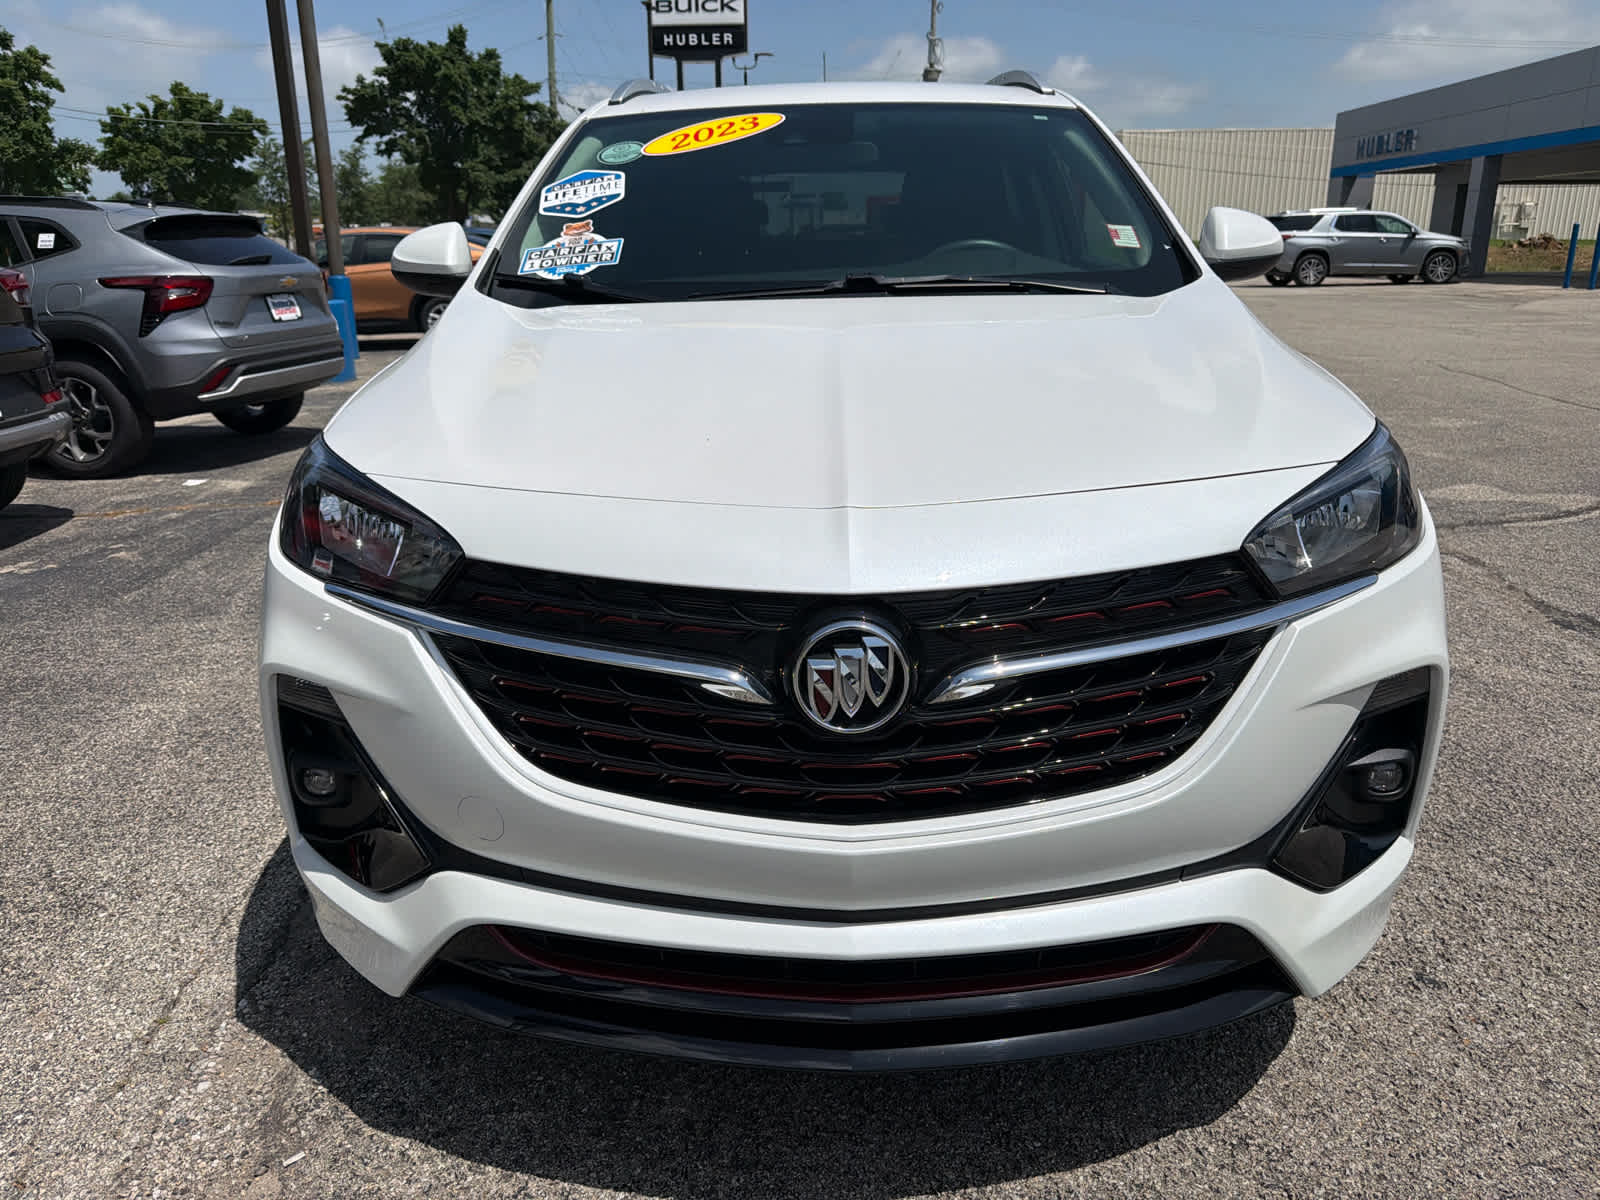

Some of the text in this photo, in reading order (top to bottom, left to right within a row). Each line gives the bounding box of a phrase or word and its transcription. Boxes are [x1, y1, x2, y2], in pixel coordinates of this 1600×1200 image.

[655, 0, 739, 13] BUICK
[663, 33, 733, 46] HUBLER
[671, 116, 760, 151] 2023
[543, 181, 623, 202] LIFETIME
[531, 244, 615, 259] CARFAX
